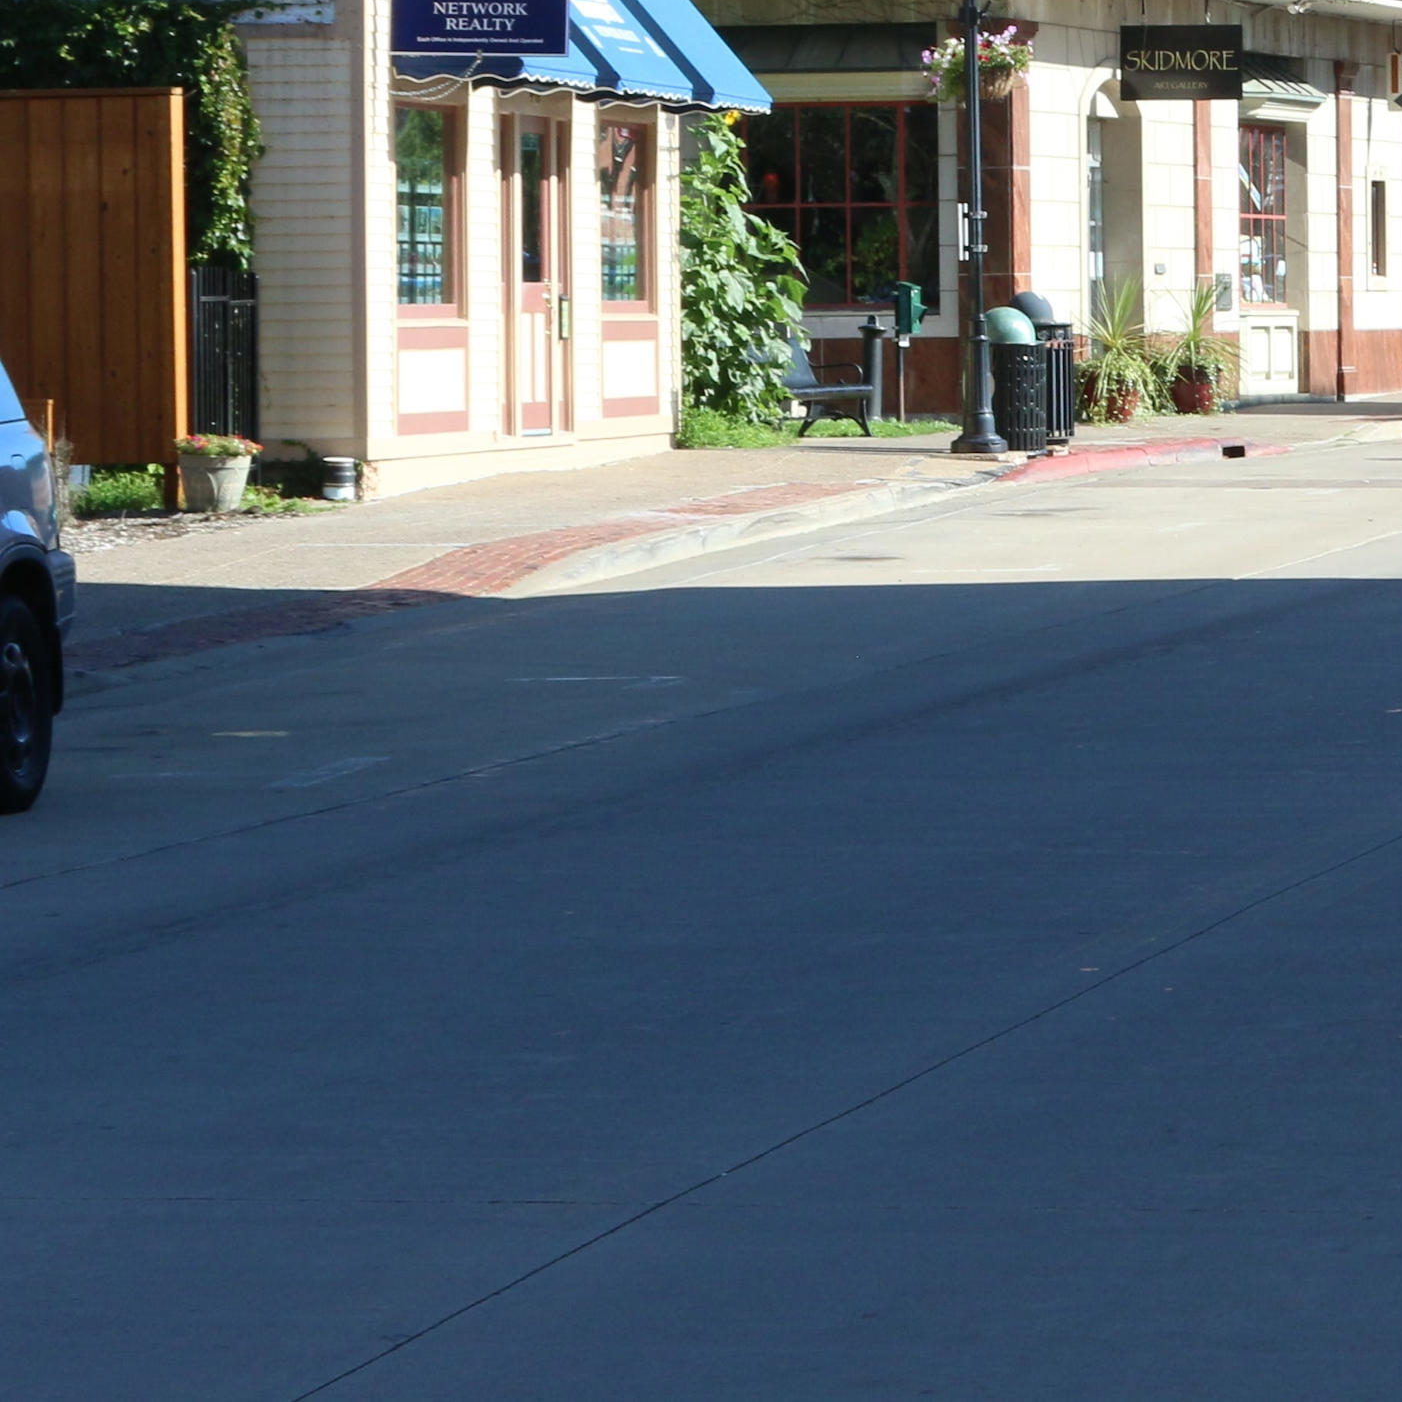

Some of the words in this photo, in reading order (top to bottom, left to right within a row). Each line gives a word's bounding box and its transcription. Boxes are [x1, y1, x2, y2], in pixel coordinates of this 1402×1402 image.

[433, 2, 528, 16] NETWORK
[445, 18, 516, 31] REALTY
[1124, 49, 1238, 71] SKIDMORE
[1154, 81, 1169, 89] ART
[1170, 81, 1208, 89] GALLERY
